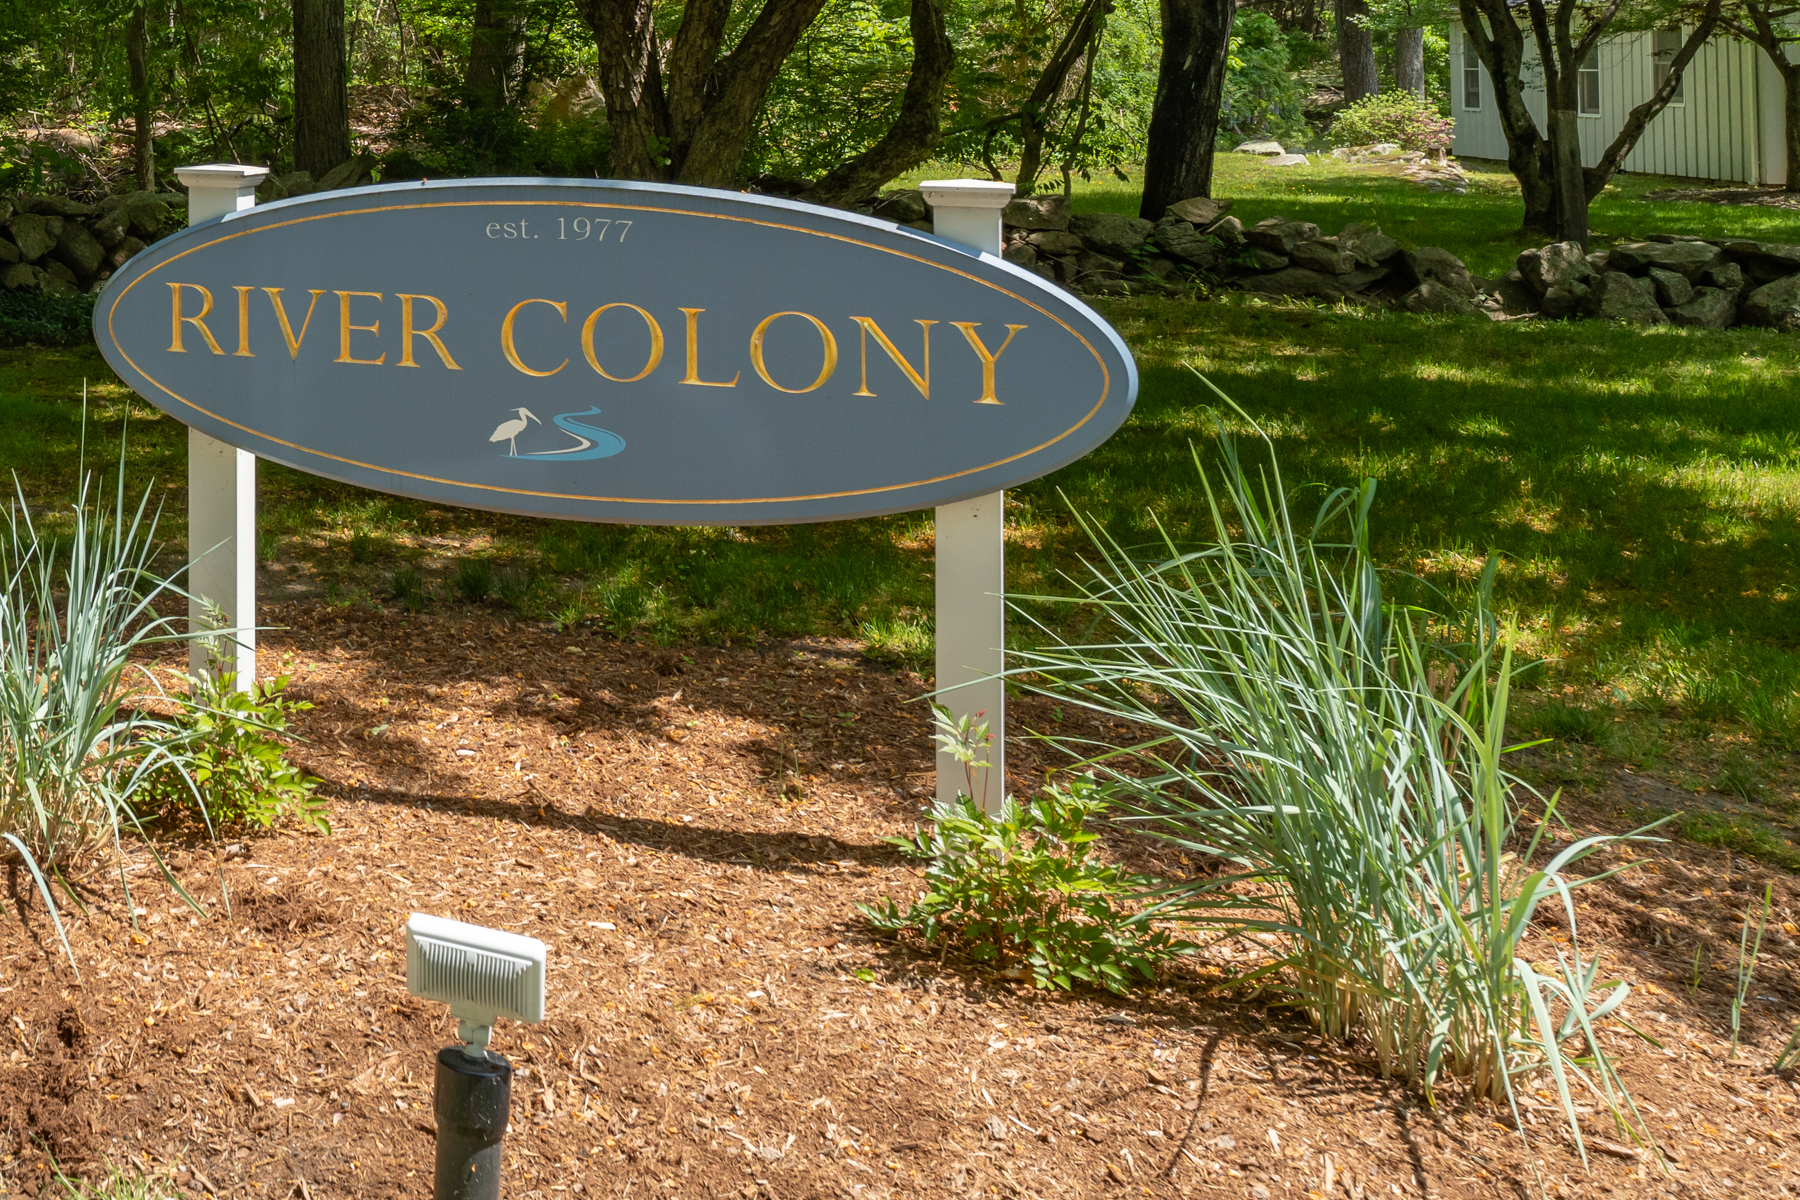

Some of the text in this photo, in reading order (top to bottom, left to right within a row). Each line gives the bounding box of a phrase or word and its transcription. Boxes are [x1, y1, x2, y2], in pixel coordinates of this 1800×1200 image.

[485, 217, 634, 244] est. 1977
[165, 282, 1029, 405] RIVER COLONY
